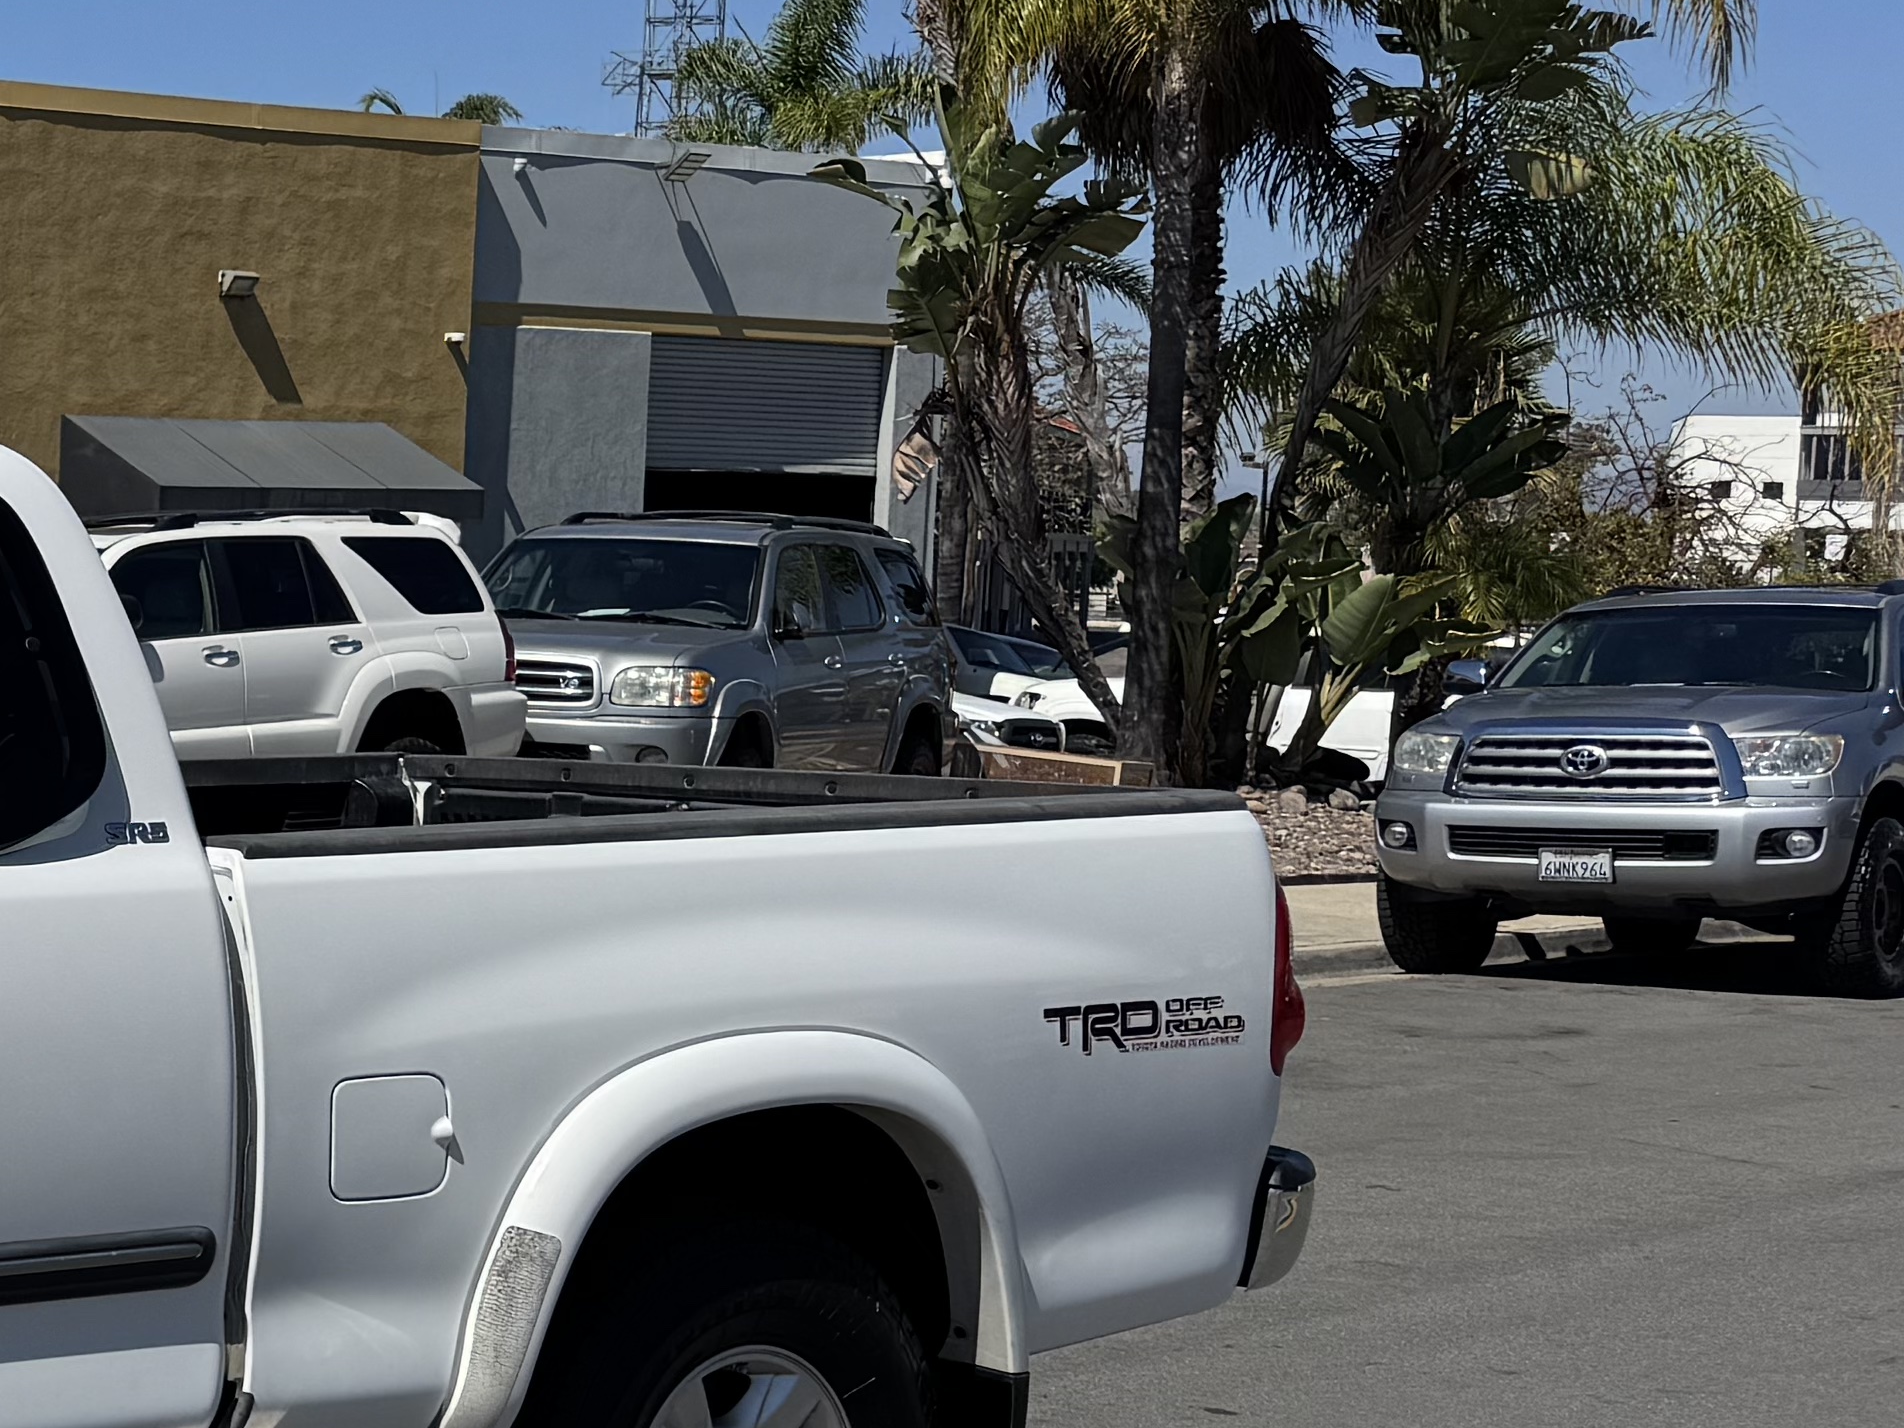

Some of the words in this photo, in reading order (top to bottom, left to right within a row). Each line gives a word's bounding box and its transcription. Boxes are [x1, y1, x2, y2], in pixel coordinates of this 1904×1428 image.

[1165, 996, 1224, 1017] OFF
[1043, 1000, 1162, 1056] TRD
[1165, 1014, 1245, 1037] ROAD
